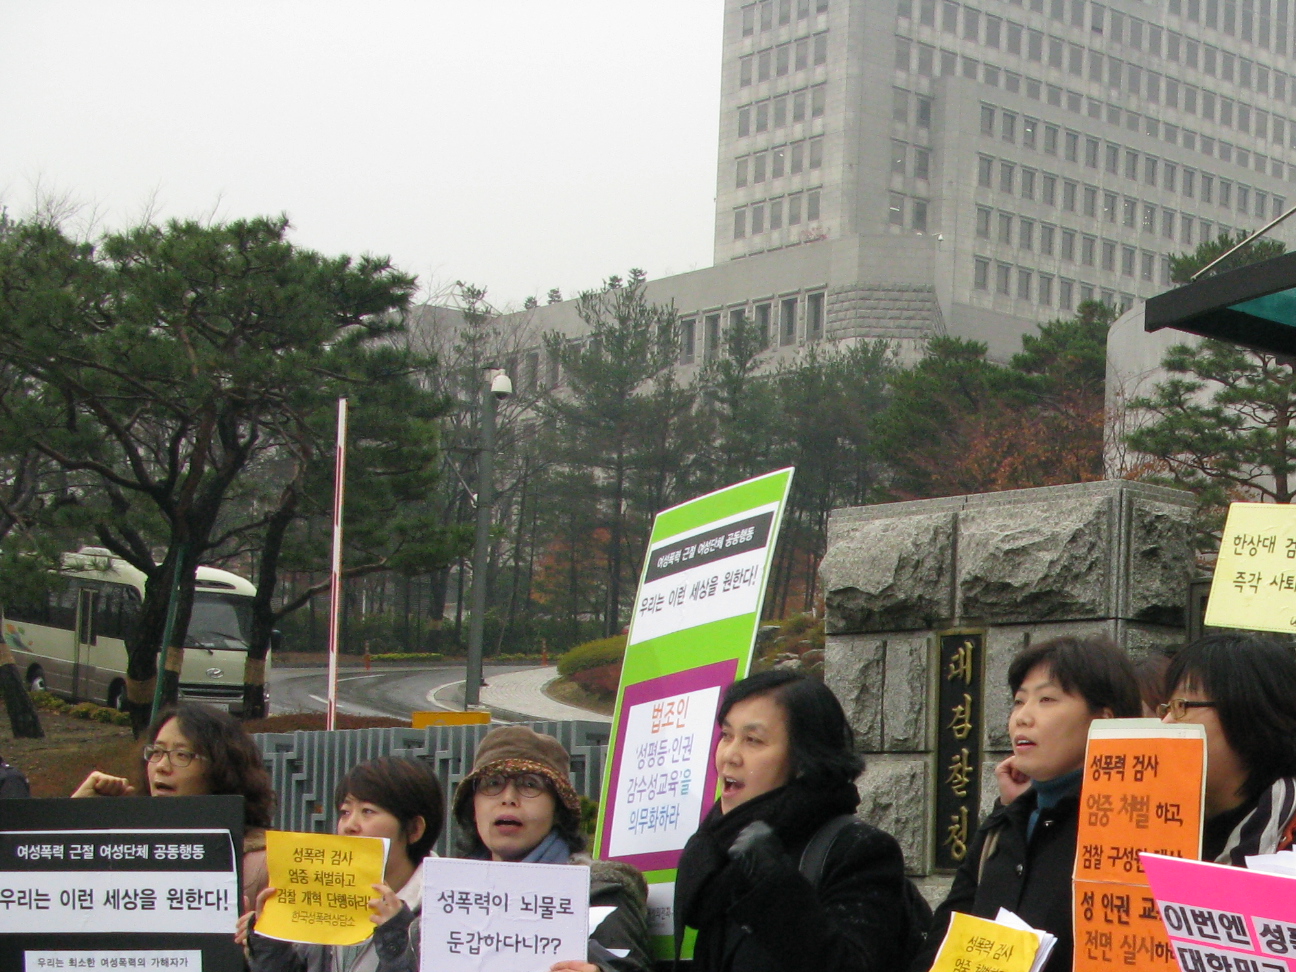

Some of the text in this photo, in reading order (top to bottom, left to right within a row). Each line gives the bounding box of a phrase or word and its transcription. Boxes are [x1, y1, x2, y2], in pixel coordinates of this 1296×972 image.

[657, 553, 682, 569] 여성폭력
[725, 526, 755, 547] 공동행동
[1233, 534, 1276, 556] 한상대
[640, 565, 759, 617] 우리는 이런 세상을 원한다!
[1233, 571, 1262, 594] 즉각
[651, 696, 690, 734] 법조인
[946, 640, 973, 861] 대검찰청
[1091, 754, 1159, 782] 성폭력 검사
[628, 803, 680, 835] 의무화하라
[1086, 793, 1114, 827] 엄중
[1118, 794, 1150, 829] 처벌
[17, 844, 205, 860] 여성폭력 근절 여성단체 공동행동
[293, 848, 353, 866] 성폭력 검사
[1083, 845, 1103, 869] 검찰
[289, 869, 355, 888] 엄중 처벌하고
[0, 888, 229, 911] 우리는 이런 세상을 원한다!
[277, 889, 296, 904] 검찰
[302, 891, 322, 907] 개혁
[438, 890, 574, 919] 성폭력이 뇌물로
[1081, 891, 1094, 921] 성
[1101, 893, 1130, 925] 인권
[292, 911, 355, 927] 한국성폭력상담소
[1163, 904, 1251, 946] 이번엔
[447, 931, 562, 955] 둔갑하다니??
[966, 935, 1014, 962] 성폭력 검사
[1085, 930, 1175, 965] 전면 실시하
[38, 957, 188, 968] 우리는 최소한 여성폭력의 가해자가
